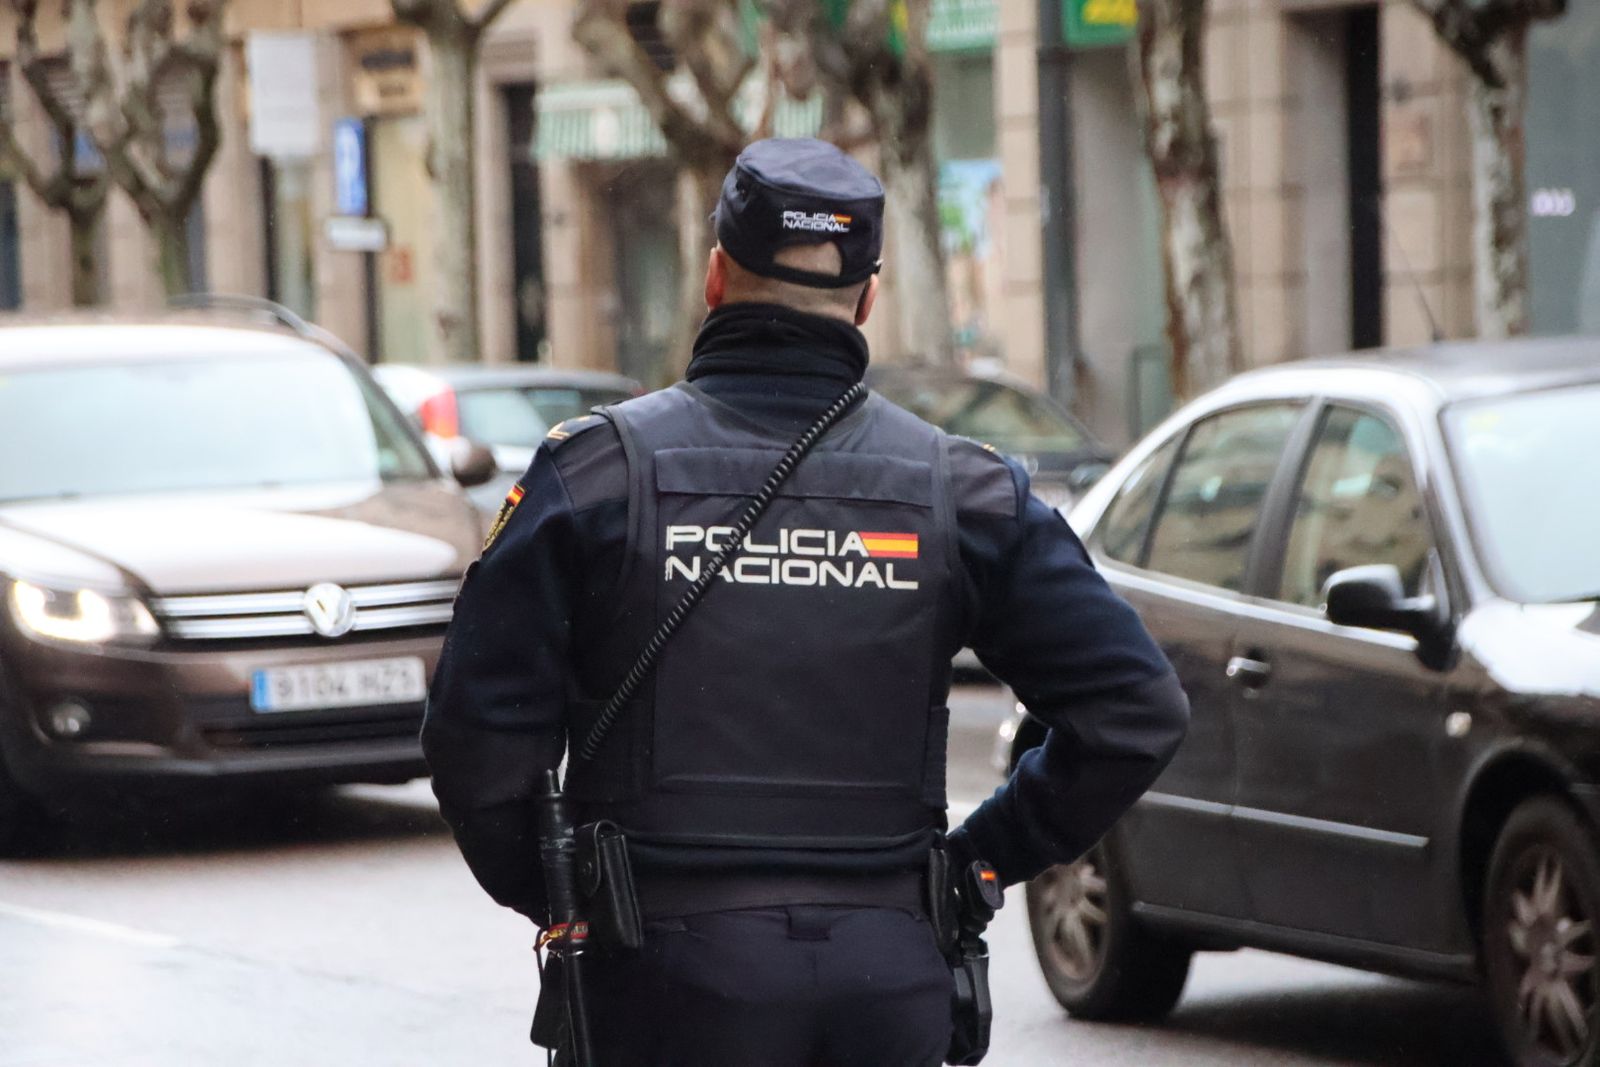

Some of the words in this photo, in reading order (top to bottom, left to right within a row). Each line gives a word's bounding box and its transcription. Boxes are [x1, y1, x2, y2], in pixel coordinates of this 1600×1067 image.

[783, 210, 836, 223] POLICIA
[783, 219, 850, 232] NACIONAL
[665, 525, 870, 558] POLICIA
